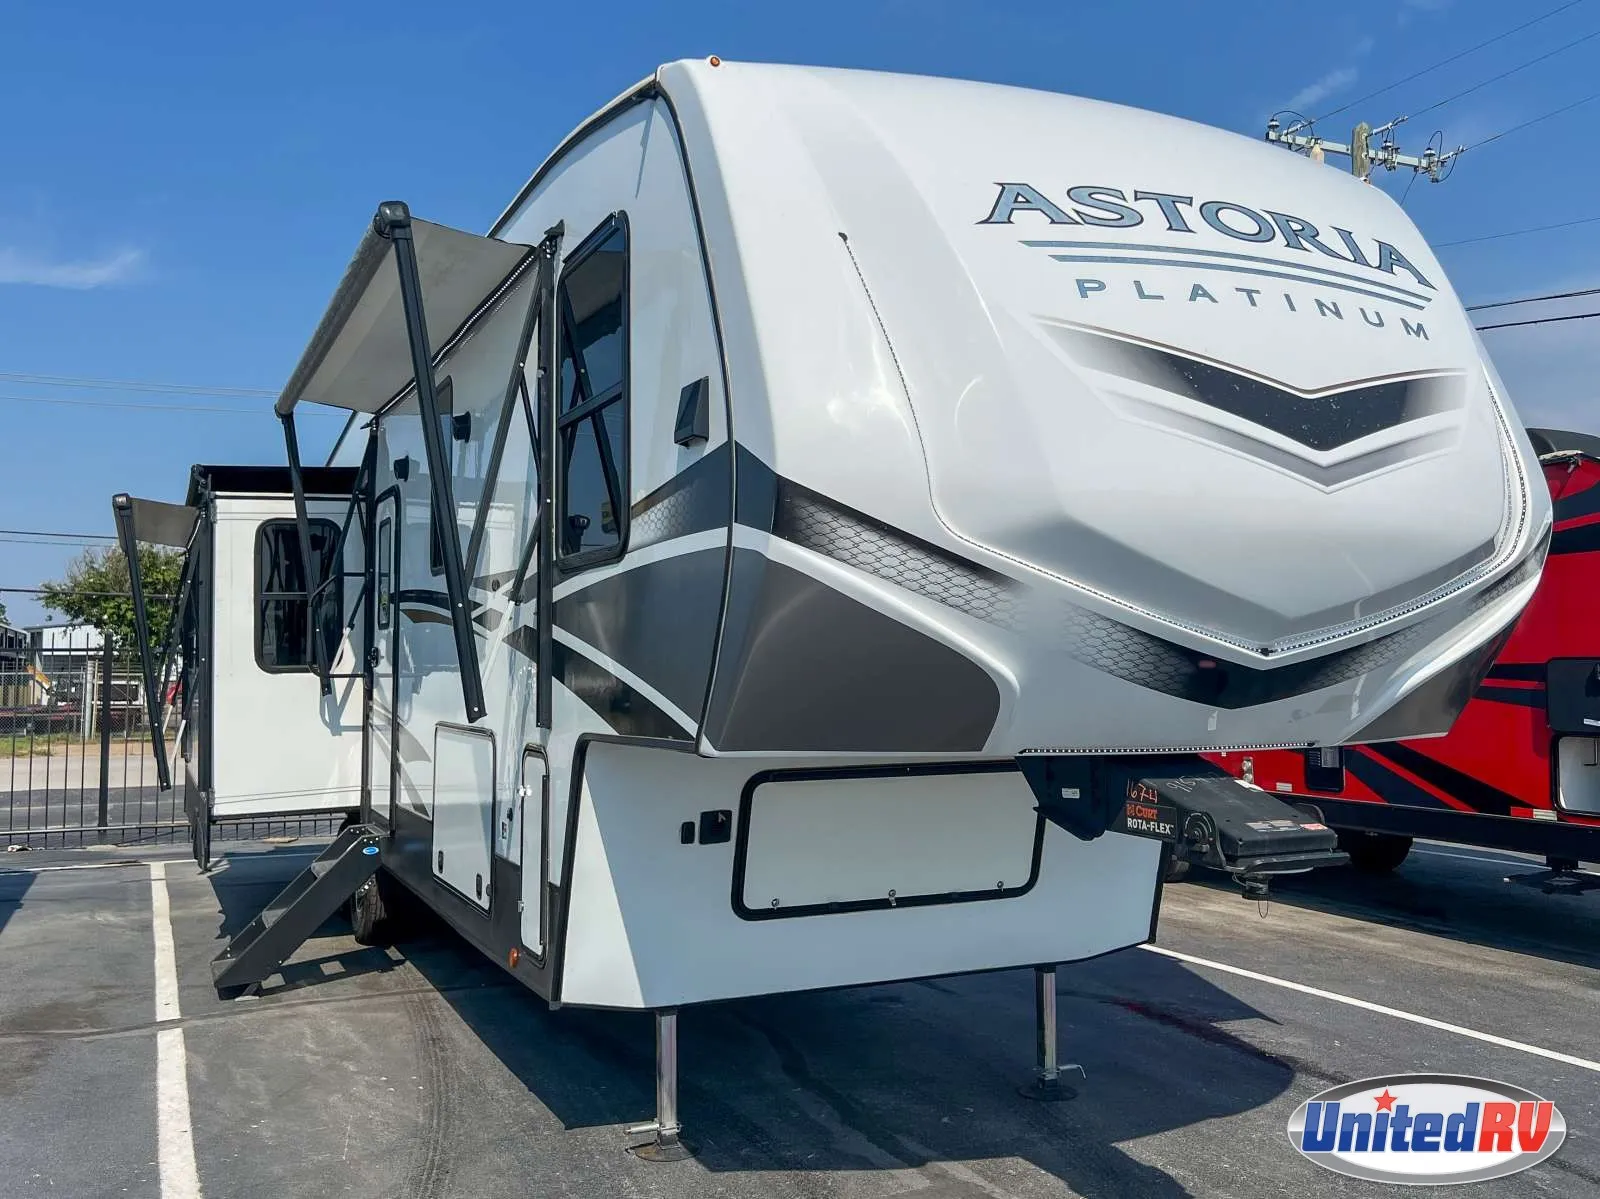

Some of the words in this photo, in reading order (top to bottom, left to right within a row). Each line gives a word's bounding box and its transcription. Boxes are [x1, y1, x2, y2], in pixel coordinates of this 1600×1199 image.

[974, 182, 1438, 291] ASTORIA
[1075, 279, 1430, 340] PLATINUM
[1136, 804, 1157, 820] CURT
